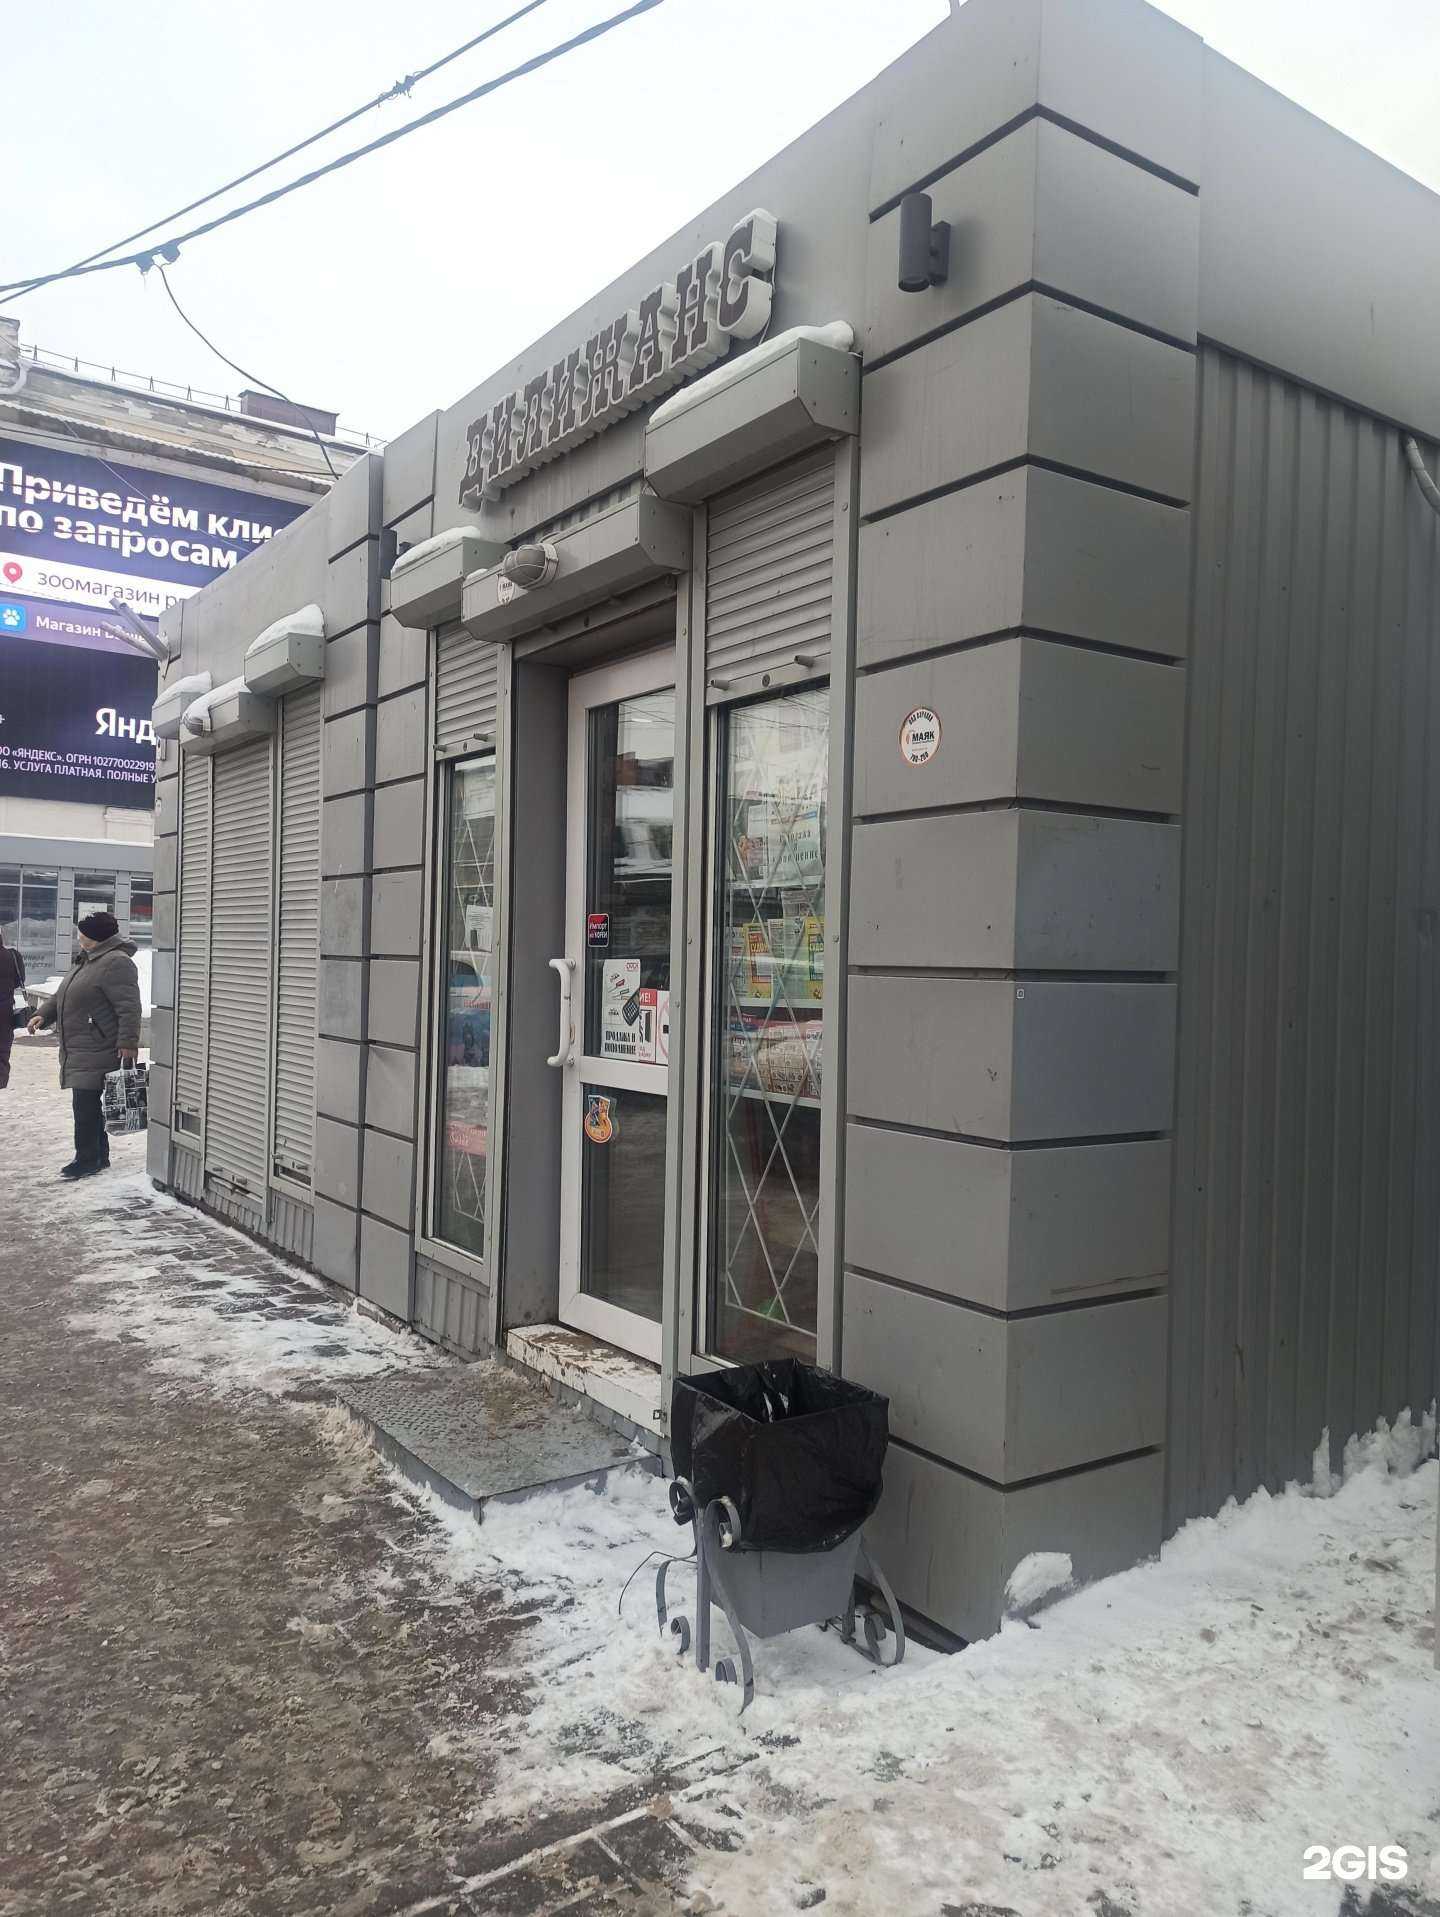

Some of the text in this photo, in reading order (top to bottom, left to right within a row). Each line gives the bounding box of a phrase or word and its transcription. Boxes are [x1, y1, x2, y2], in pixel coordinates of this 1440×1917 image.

[458, 208, 779, 512] ДИЛИЖАНС
[0, 462, 198, 531] Приведём
[0, 505, 237, 570] по запросам
[38, 572, 160, 605] зоомагазин
[36, 615, 101, 638] Магазин
[911, 730, 935, 742] МАЯК
[14, 760, 52, 774] УСЛУГА
[54, 764, 105, 779] ПЛАТНАЯ.
[107, 769, 149, 783] ПОЛНЫЕ
[66, 753, 91, 765] ОГРН
